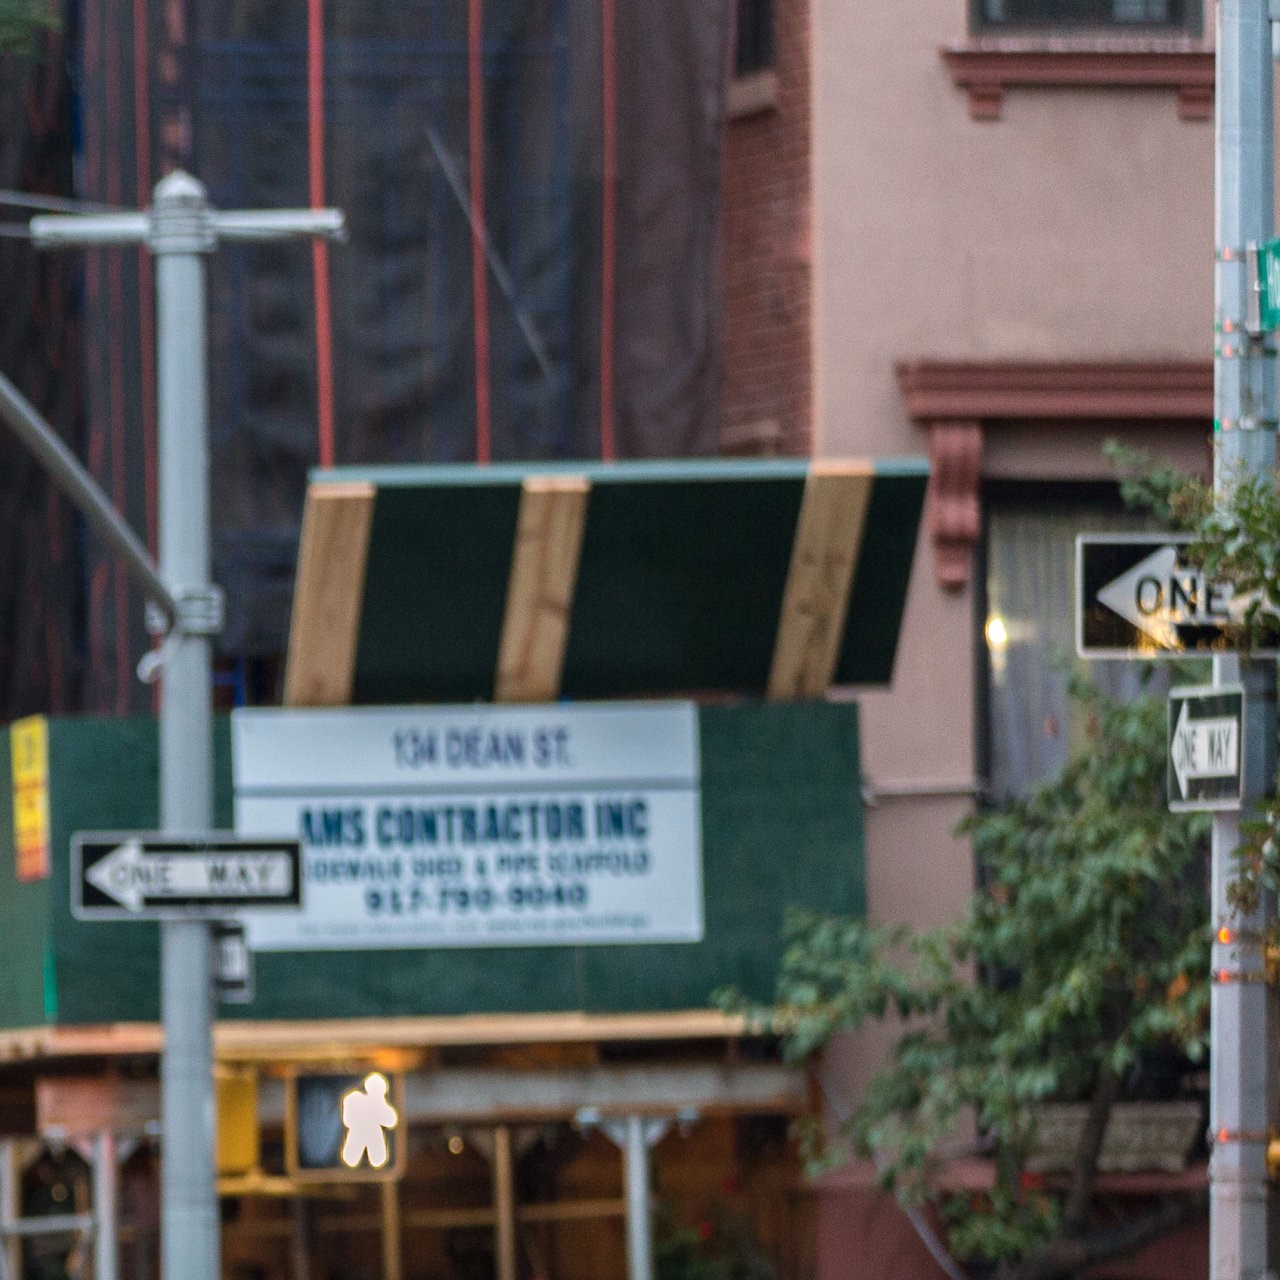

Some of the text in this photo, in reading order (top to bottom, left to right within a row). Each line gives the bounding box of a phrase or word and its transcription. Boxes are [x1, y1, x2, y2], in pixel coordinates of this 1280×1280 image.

[445, 725, 525, 770] DEAN
[1206, 727, 1231, 769] WAY
[376, 802, 588, 846] CONTRACTOR
[595, 799, 649, 841] INC
[110, 860, 274, 888] ONE WAY
